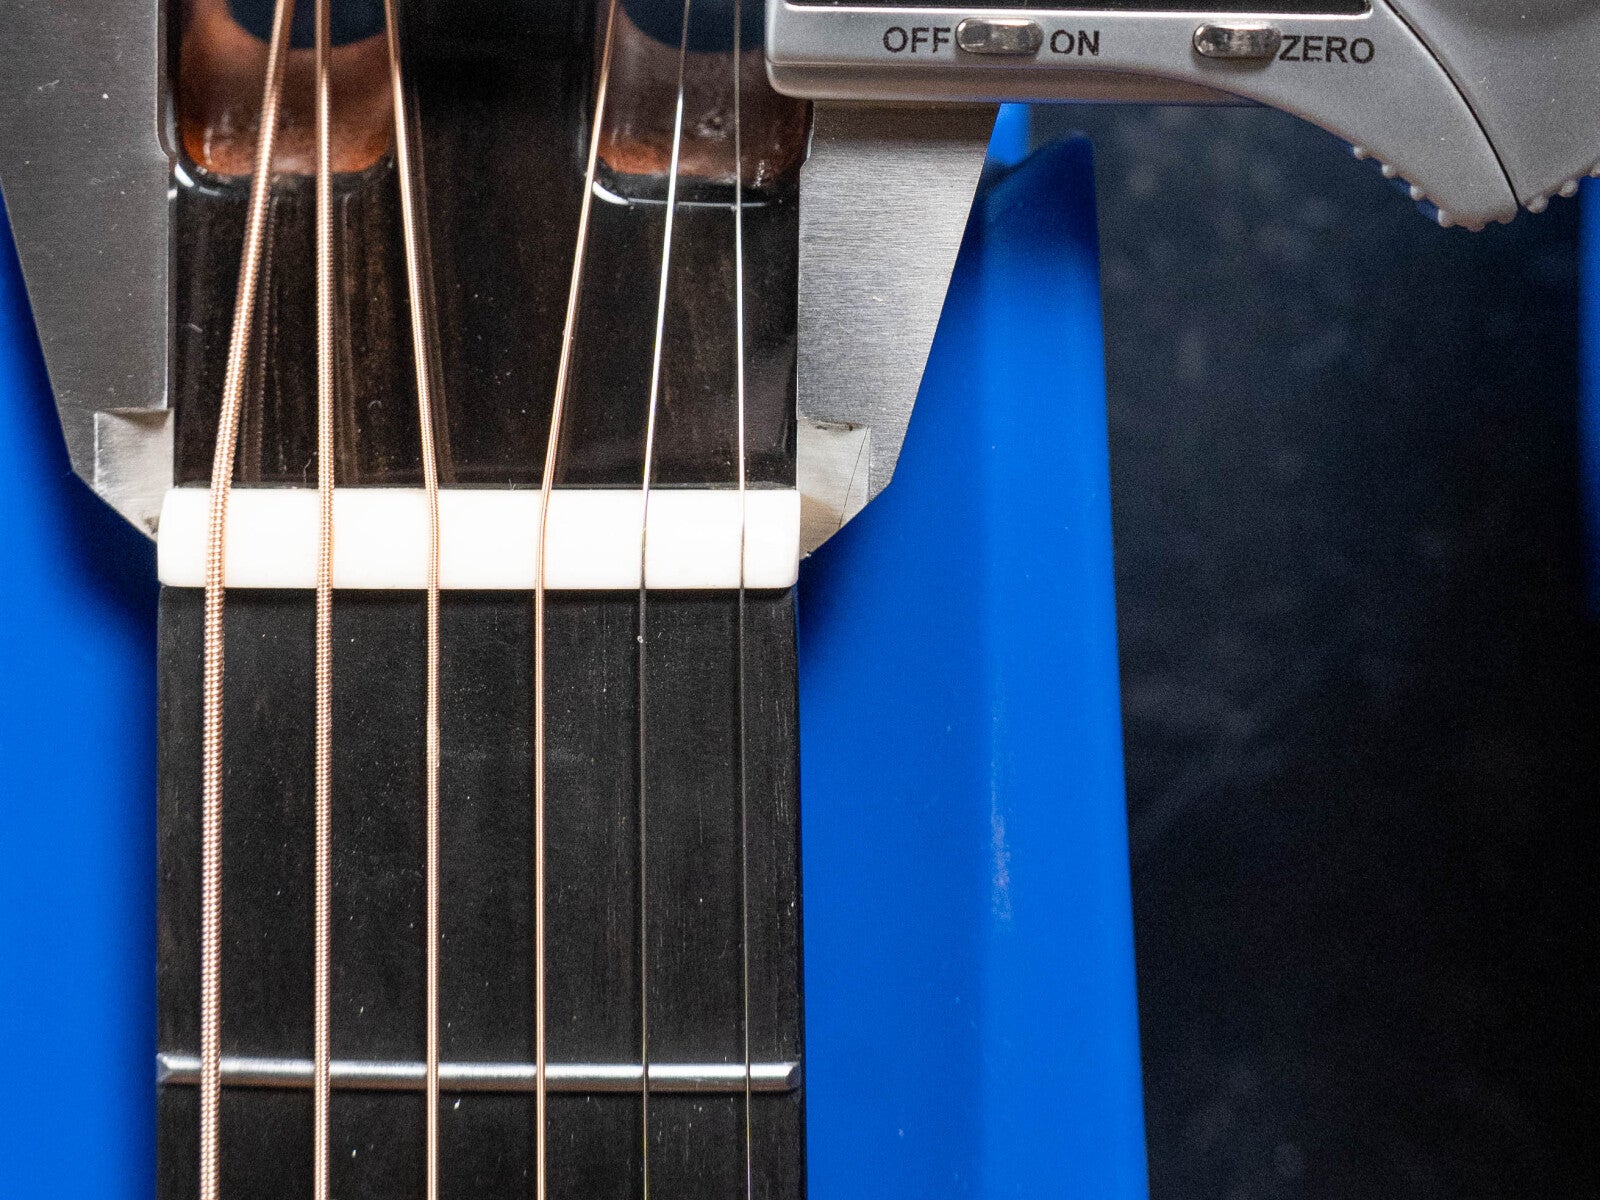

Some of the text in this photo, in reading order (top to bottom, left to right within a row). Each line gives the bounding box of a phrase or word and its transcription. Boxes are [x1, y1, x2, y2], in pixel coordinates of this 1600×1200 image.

[883, 26, 1099, 56] OFF ON
[1279, 35, 1375, 64] ZERO
